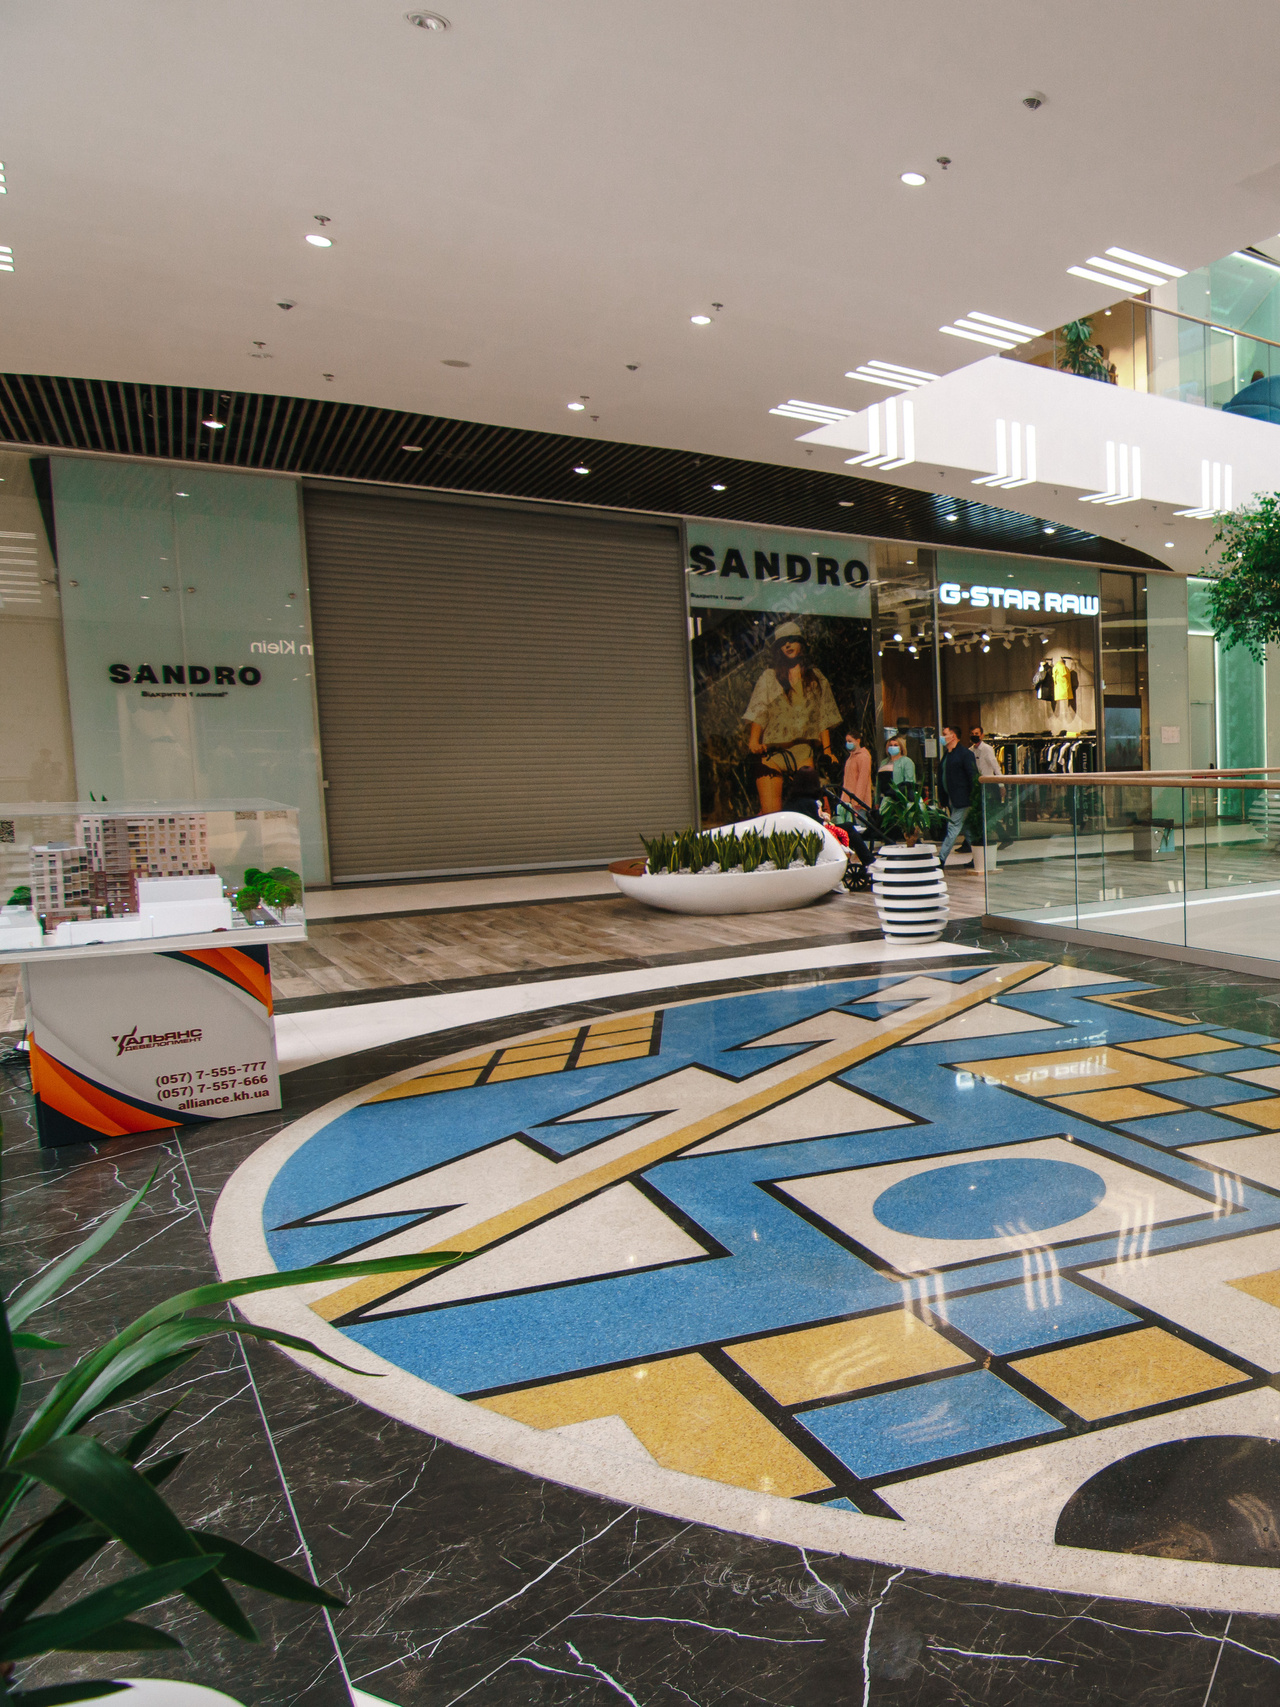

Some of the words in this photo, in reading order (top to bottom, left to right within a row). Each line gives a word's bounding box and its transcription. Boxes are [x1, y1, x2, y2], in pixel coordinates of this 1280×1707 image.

[689, 544, 869, 588] SANDRO
[939, 582, 1041, 611] G-STAR
[1044, 592, 1100, 616] RAW
[108, 663, 262, 686] SANDRO
[125, 1037, 203, 1052] ДЕВЕЛОПМЕНТ
[156, 1071, 193, 1088] (057)
[195, 1061, 267, 1079] 7-555-777
[157, 1085, 194, 1101] (057)
[197, 1074, 269, 1094] 7-557-666
[178, 1088, 270, 1111] alliance.kh.ua
